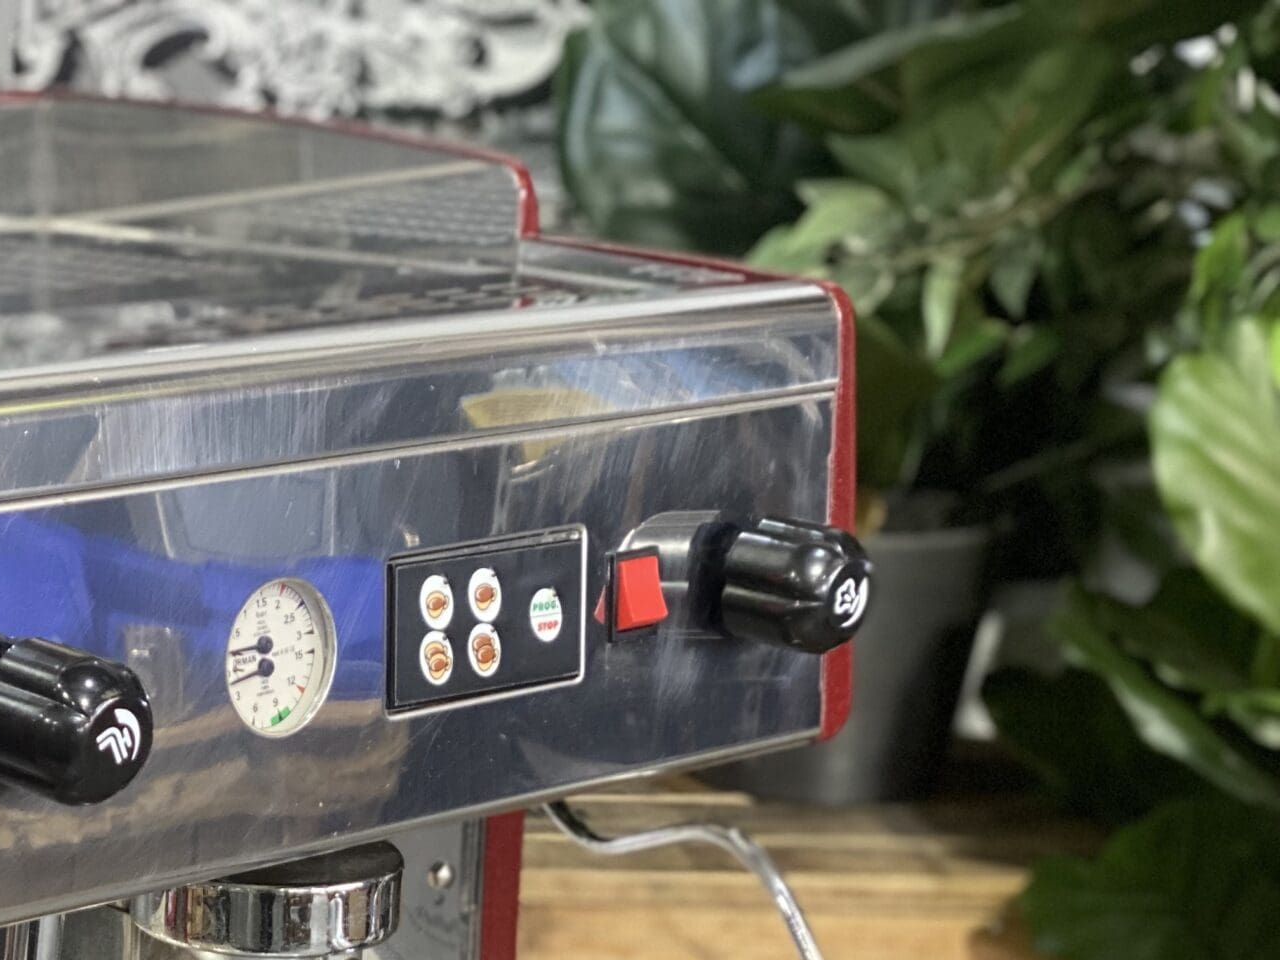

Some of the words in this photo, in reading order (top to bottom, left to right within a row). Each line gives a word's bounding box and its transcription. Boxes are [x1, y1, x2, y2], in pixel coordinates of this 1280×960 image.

[256, 598, 267, 608] 1.5
[275, 600, 281, 610] 2
[532, 600, 559, 612] PROG.
[537, 620, 559, 631] STOP
[296, 632, 302, 641] 3
[295, 651, 303, 660] 15
[287, 676, 296, 686] 12
[235, 691, 241, 701] 3
[273, 697, 279, 707] 9
[252, 703, 258, 713] 6
